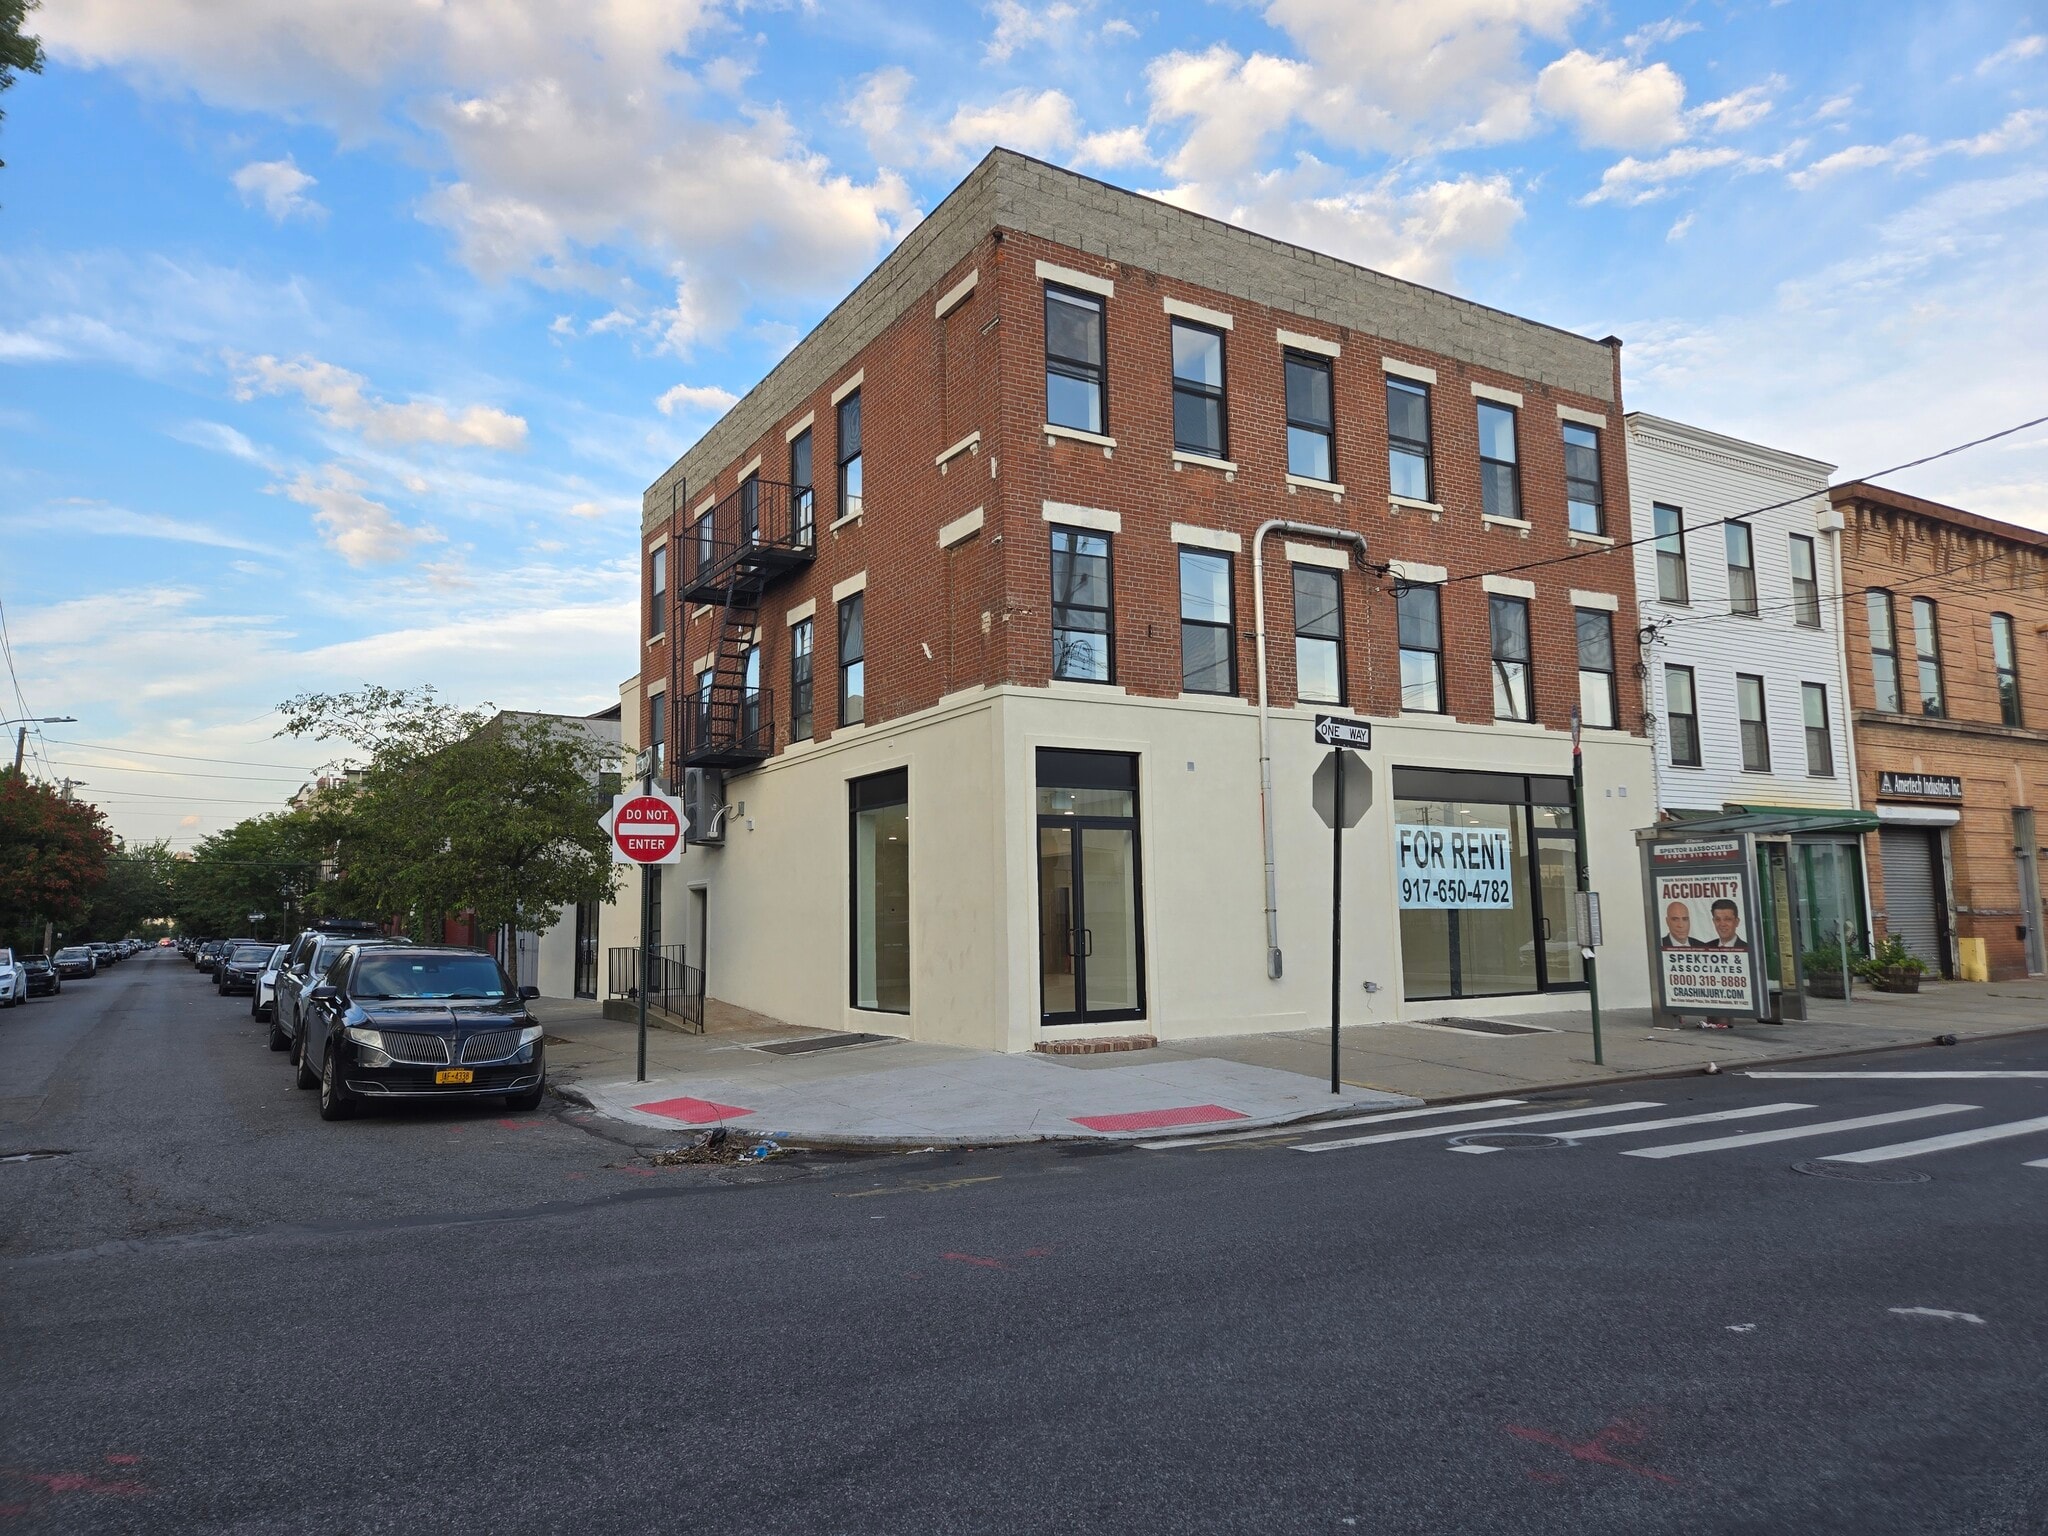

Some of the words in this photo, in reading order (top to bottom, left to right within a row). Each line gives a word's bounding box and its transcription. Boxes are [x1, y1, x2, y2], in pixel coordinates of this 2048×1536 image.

[1321, 724, 1340, 737] ONE
[1350, 728, 1367, 741] WAY
[1894, 774, 1922, 794] Amertech
[1951, 779, 1962, 796] Inc.
[626, 809, 642, 820] DO
[646, 810, 669, 820] NOT
[628, 839, 666, 850] ENTER
[1400, 830, 1446, 869] FOR
[1452, 832, 1506, 870] RENT
[1694, 844, 1733, 852] ASSOCIATES
[1402, 878, 1510, 903] 917-650-4782
[1663, 882, 1738, 899] ACCIDENT?
[1669, 954, 1729, 964] SPEKTOR
[1734, 955, 1742, 964] &
[1670, 965, 1743, 974] ASSOCIATES
[1669, 974, 1697, 986] (800)
[1699, 976, 1747, 988] 318-8888
[1674, 987, 1744, 1000] CRASHINJURY.COM
